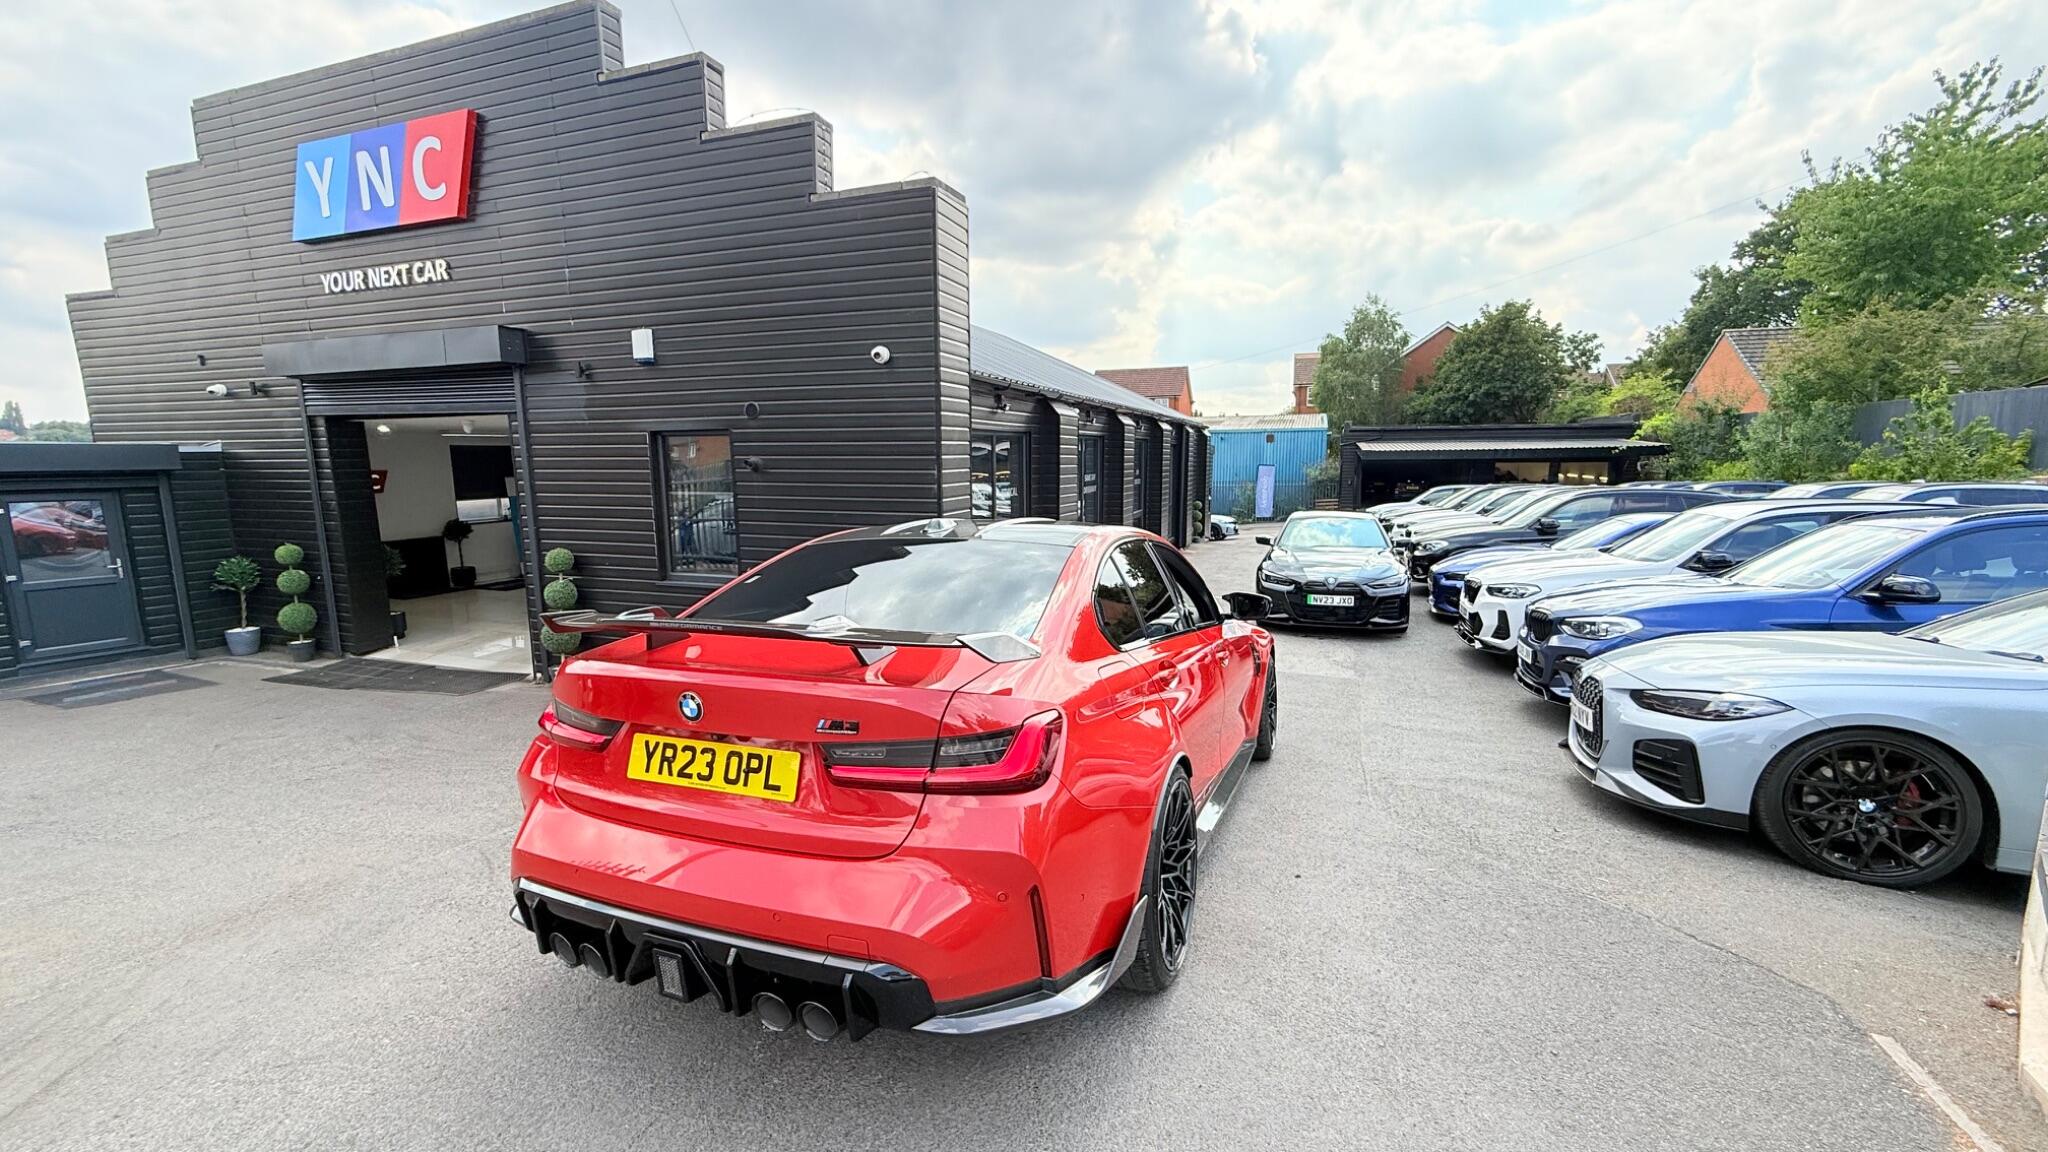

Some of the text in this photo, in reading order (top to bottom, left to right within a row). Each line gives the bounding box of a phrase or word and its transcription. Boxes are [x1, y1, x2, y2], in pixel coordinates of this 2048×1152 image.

[304, 136, 446, 217] YNC
[320, 258, 449, 294] YOUR NEXT CAR
[1312, 596, 1335, 604] NV23
[644, 740, 781, 792] YR23 OPL
